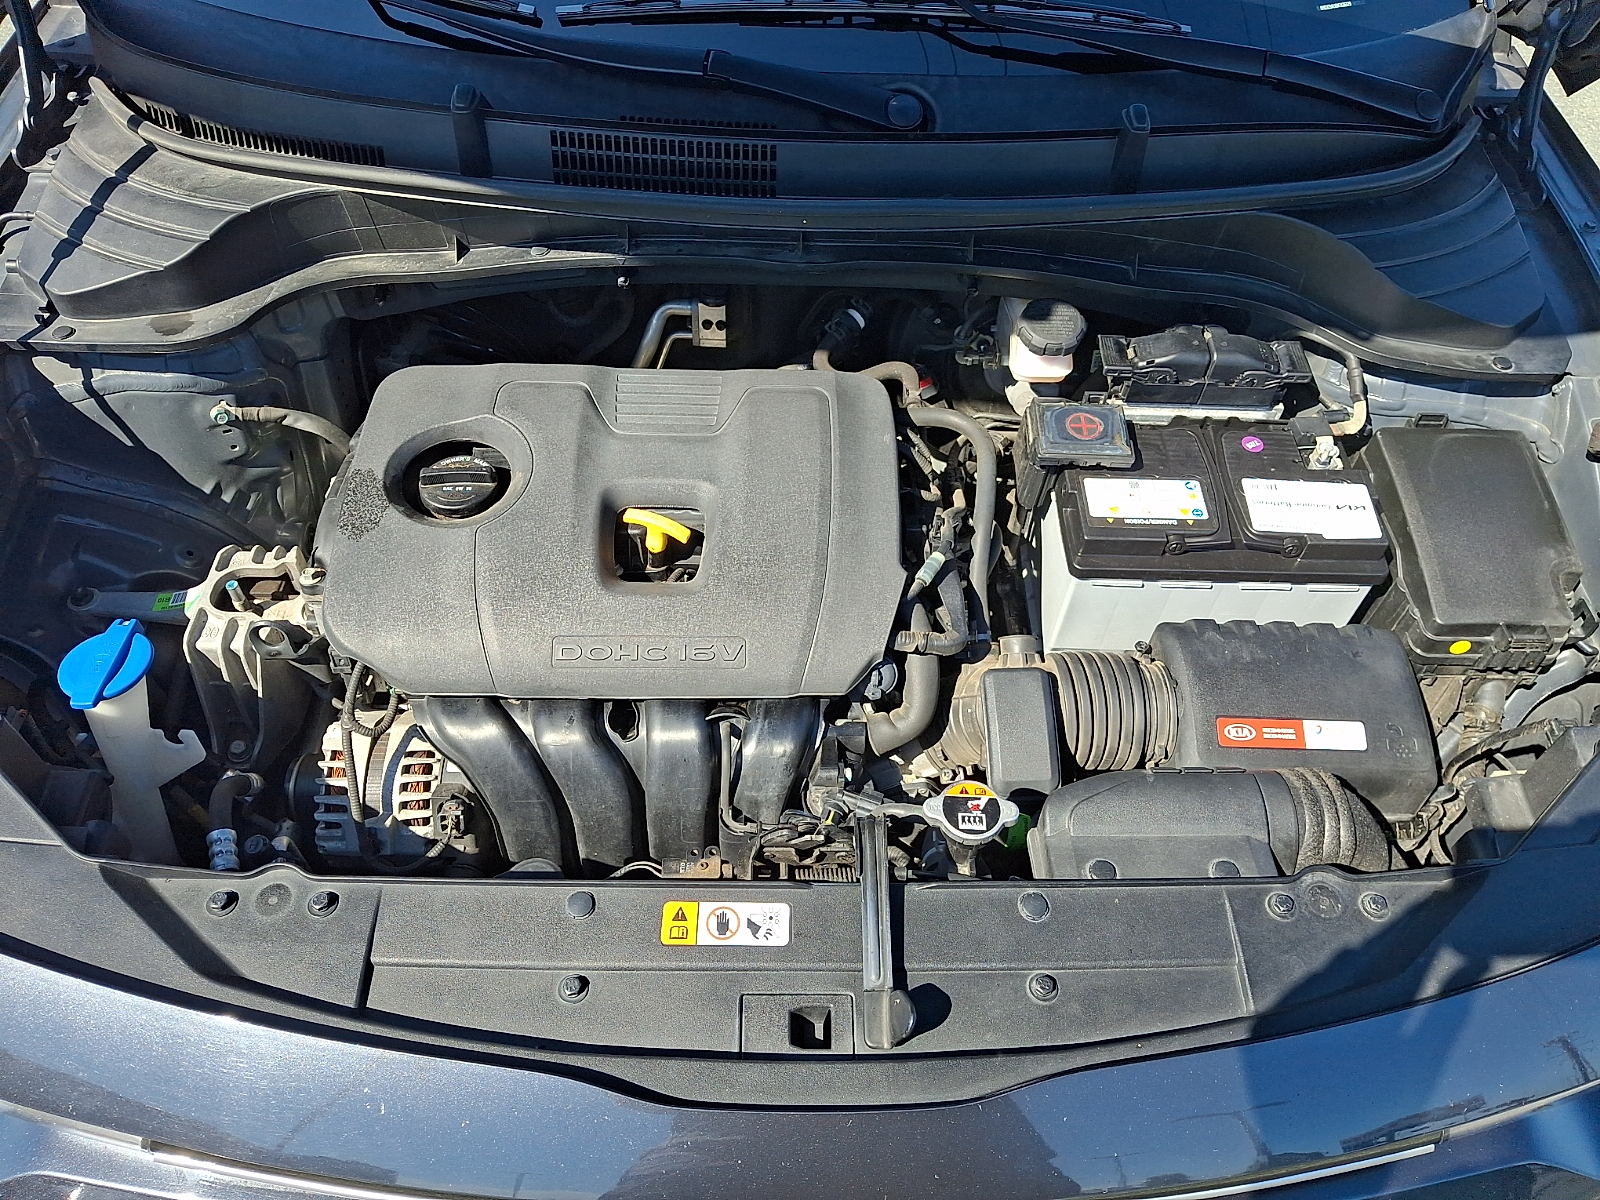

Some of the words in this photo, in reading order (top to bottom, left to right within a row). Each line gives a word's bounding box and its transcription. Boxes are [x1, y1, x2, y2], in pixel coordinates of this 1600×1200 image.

[554, 644, 668, 662] DOHC
[678, 644, 744, 662] 16V
[1228, 726, 1252, 739] KIA
